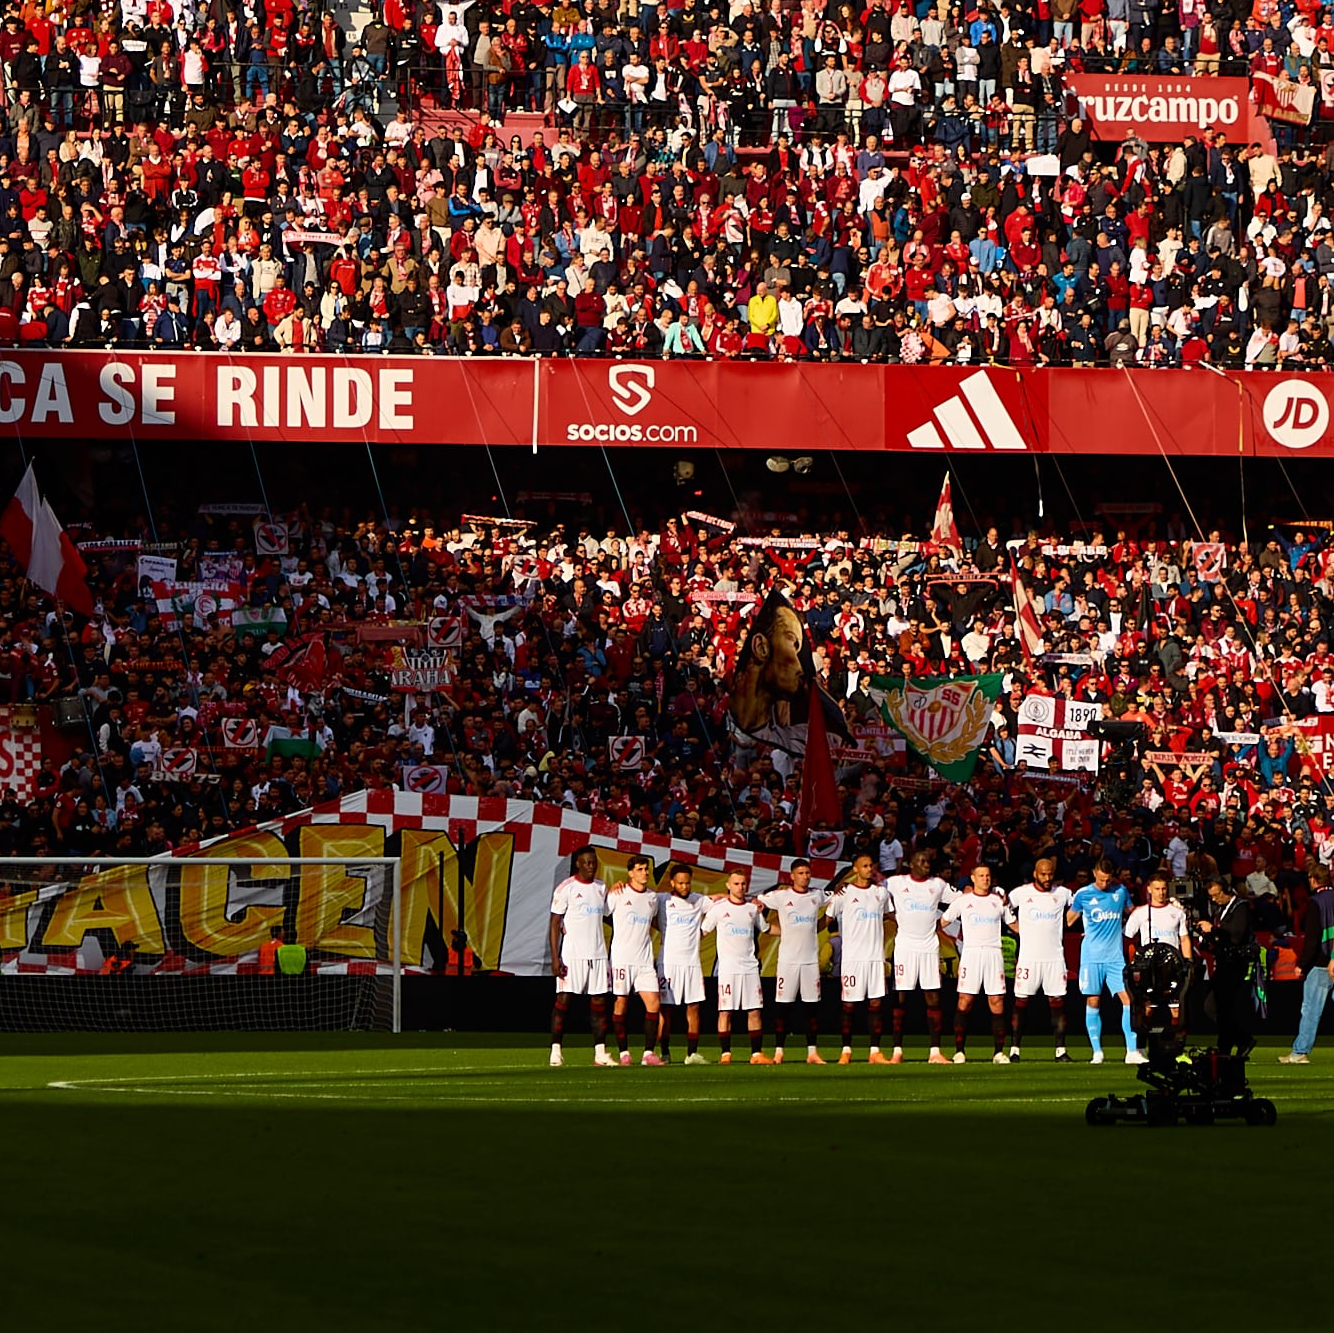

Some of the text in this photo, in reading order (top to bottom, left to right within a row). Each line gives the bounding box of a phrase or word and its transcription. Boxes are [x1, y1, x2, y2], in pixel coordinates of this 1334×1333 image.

[1104, 83, 1192, 93] DESDE 1904
[98, 363, 176, 426] SE
[217, 365, 415, 431] RINDE
[1273, 397, 1320, 429] JD
[1069, 708, 1096, 723] 1890
[1035, 727, 1082, 739] ALGABA
[193, 772, 219, 784] 75
[614, 967, 626, 982] 16
[894, 964, 905, 978] 19
[960, 966, 967, 979] 3
[1016, 967, 1030, 980] 23
[777, 977, 785, 991] 2
[842, 975, 857, 988] 20
[720, 984, 733, 997] 14
